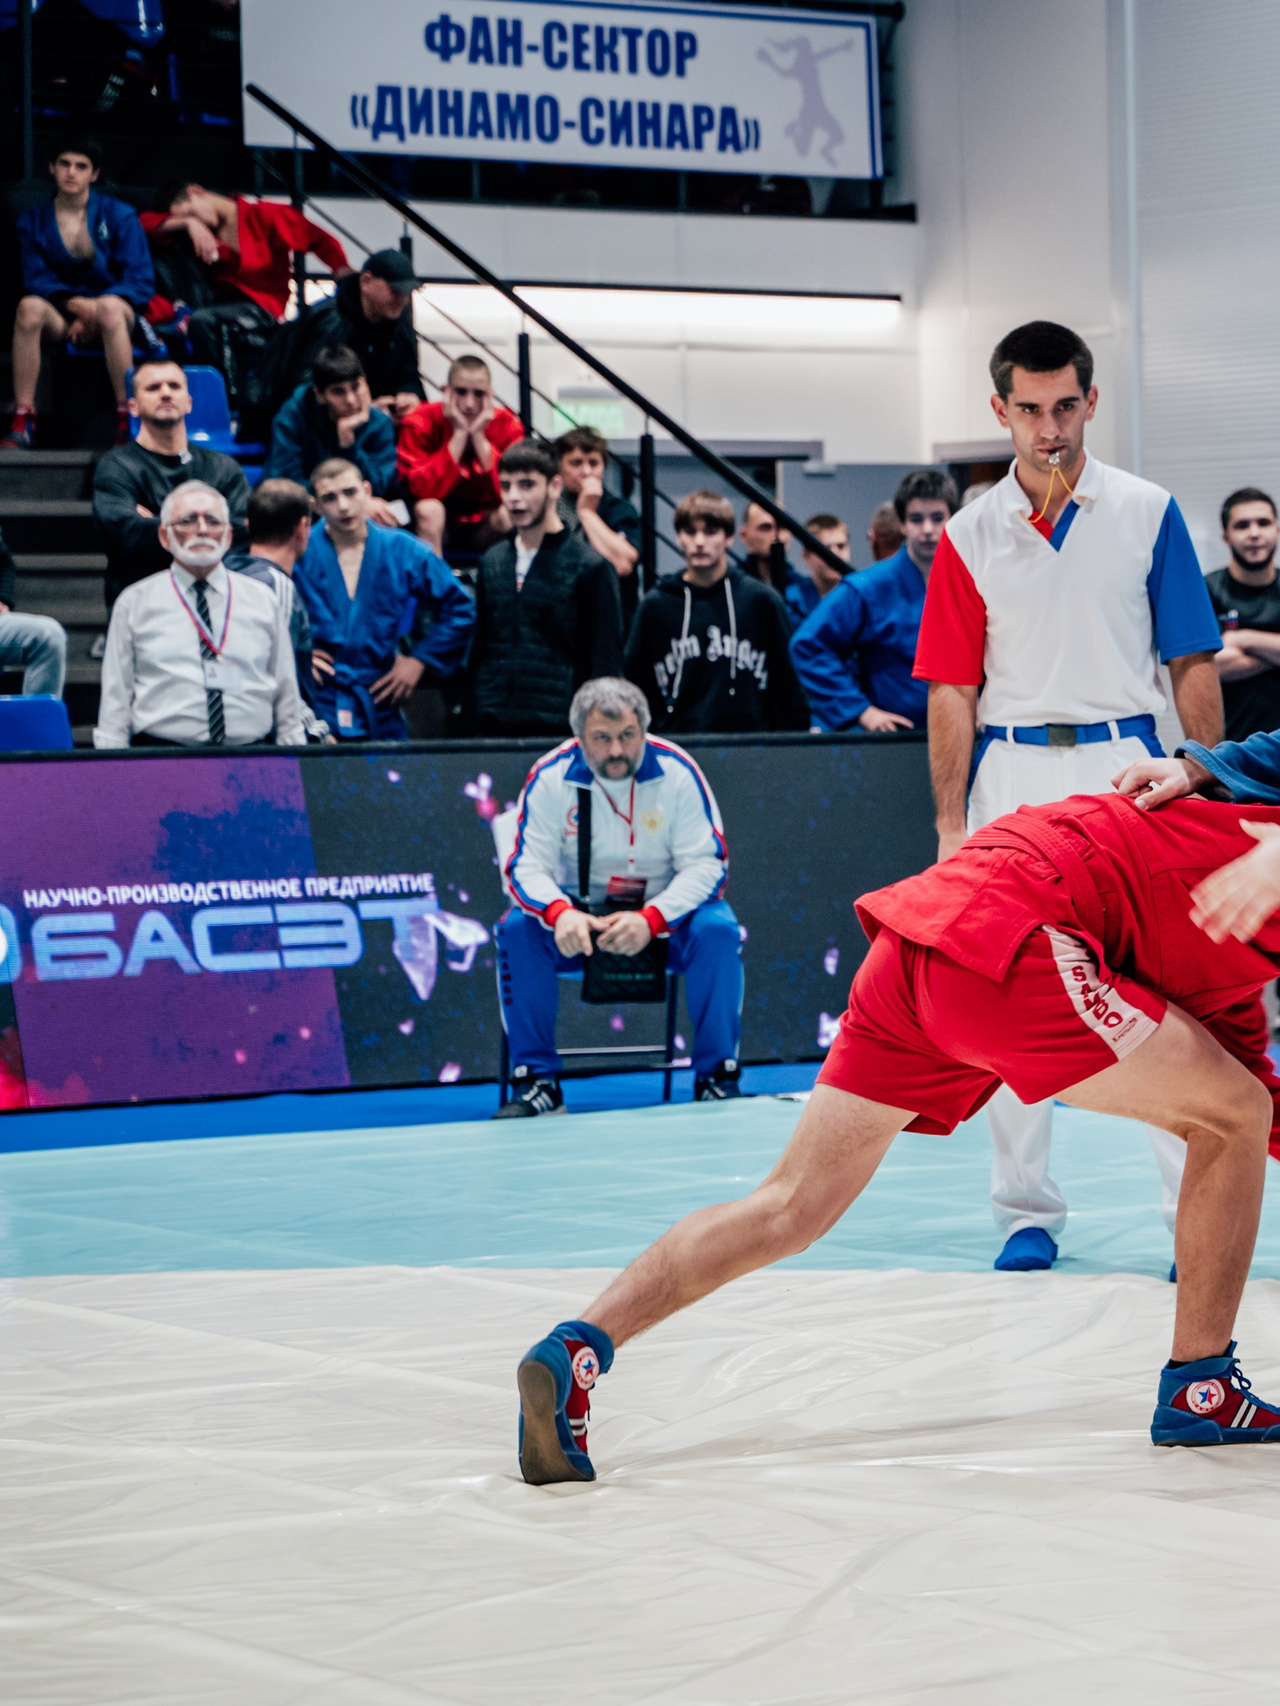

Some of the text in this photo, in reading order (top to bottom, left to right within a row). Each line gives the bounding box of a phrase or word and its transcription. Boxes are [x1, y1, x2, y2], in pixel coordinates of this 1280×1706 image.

[424, 13, 698, 77] ФАН-СЕКТОР
[350, 84, 760, 153] «ДИНАМО-СИНАРА»
[23, 873, 435, 909] НАУЧНО-ПРОИЗВОДСТВЕННОЕ ПРЕДПРИЯТИЕ
